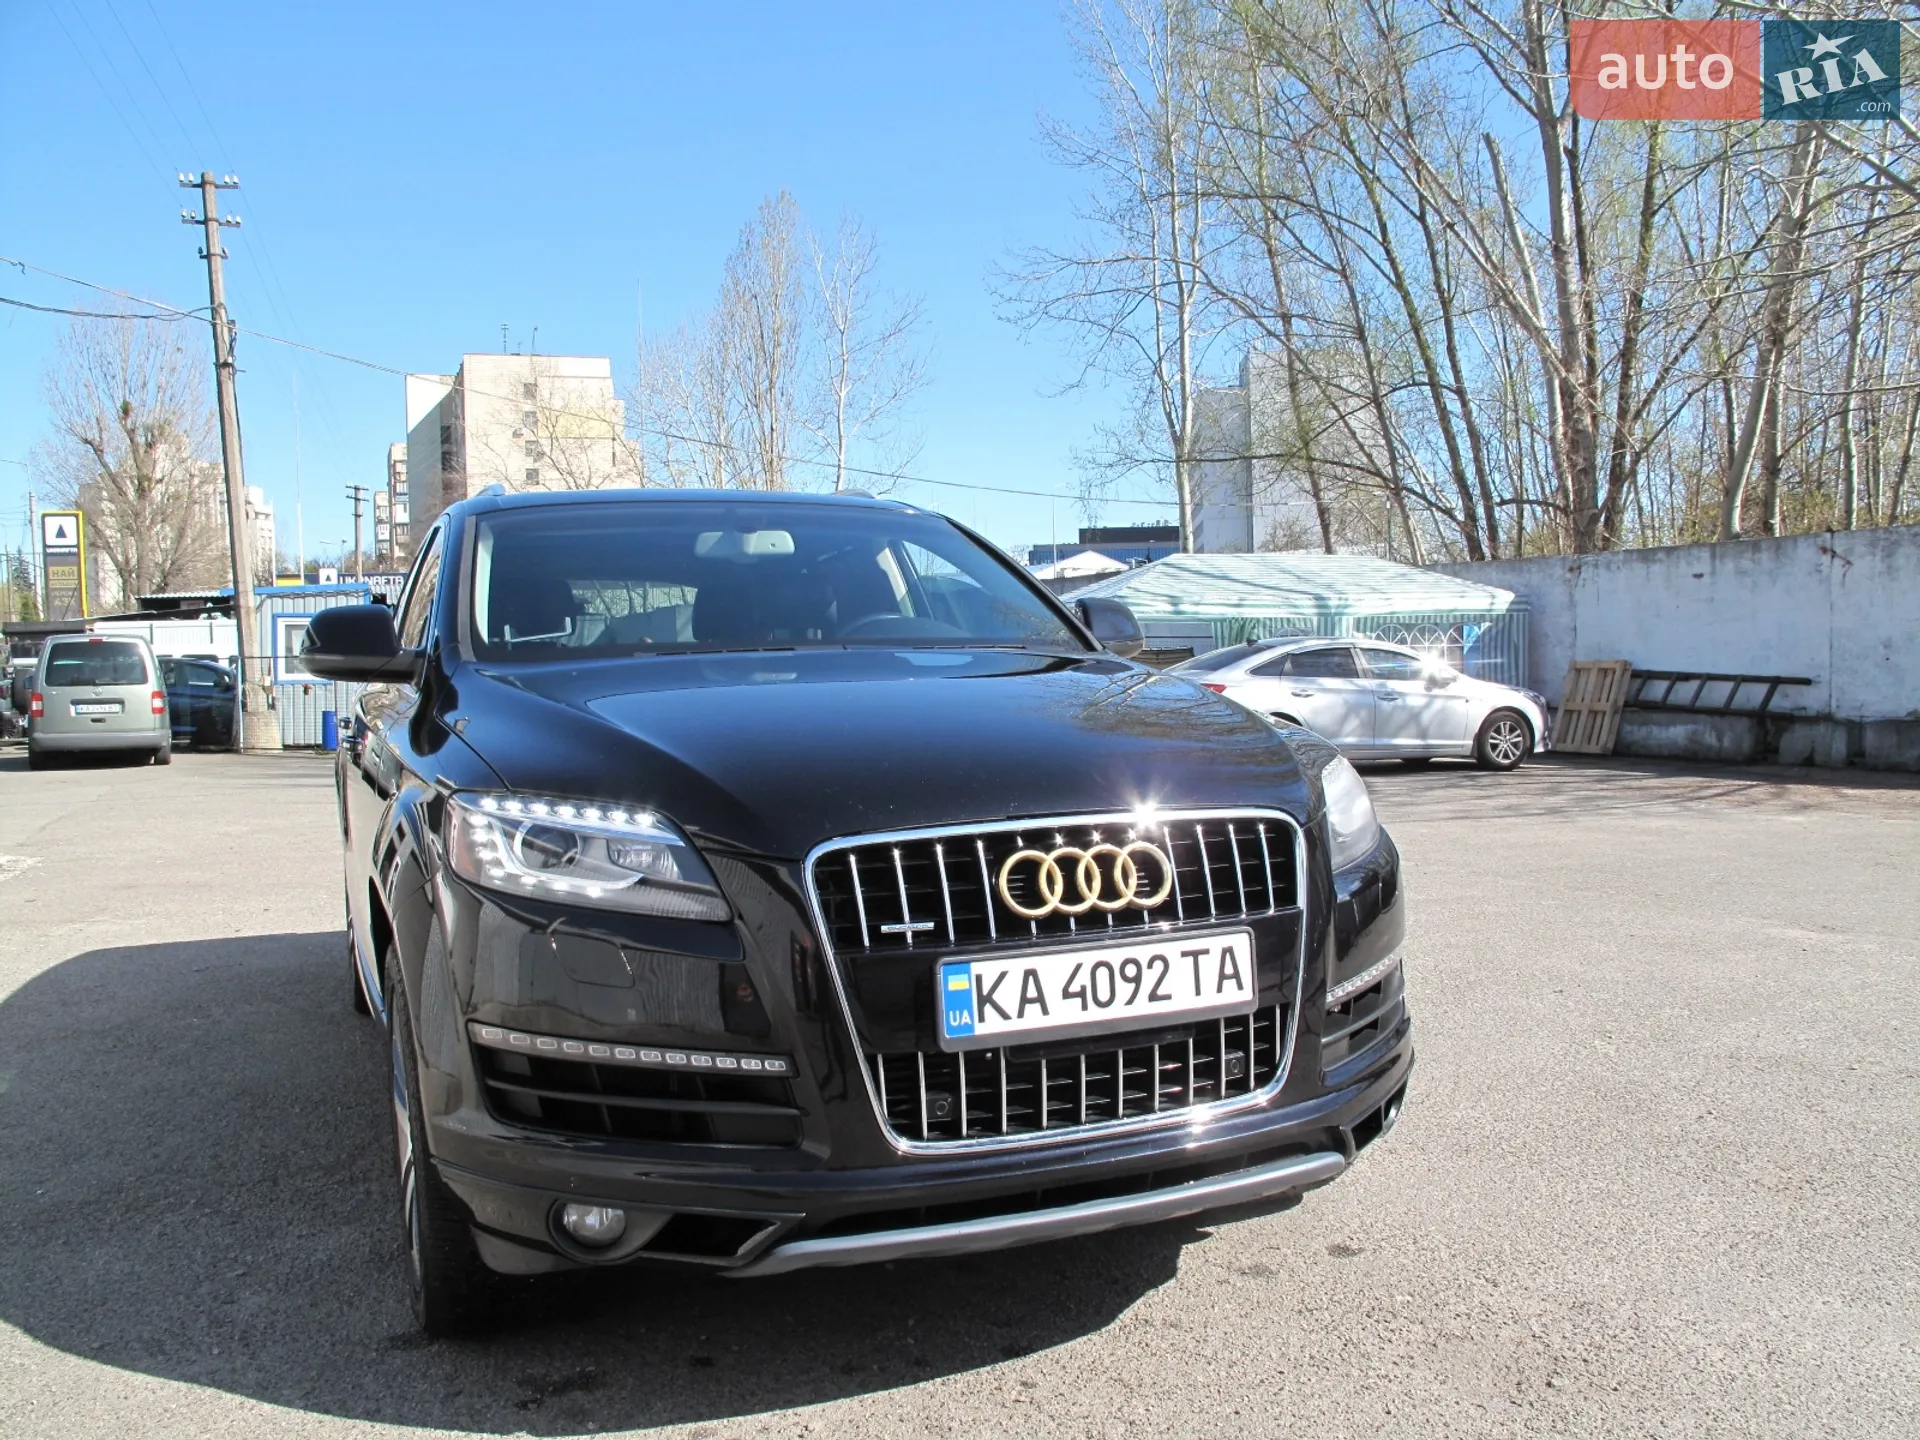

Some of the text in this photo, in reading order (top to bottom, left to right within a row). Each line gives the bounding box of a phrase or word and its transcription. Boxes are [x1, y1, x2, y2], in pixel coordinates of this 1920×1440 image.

[52, 567, 75, 578] НАЙ
[339, 575, 404, 586] UKNAFTA
[974, 945, 1244, 1024] KA 4092 TA
[949, 1009, 972, 1027] UA
